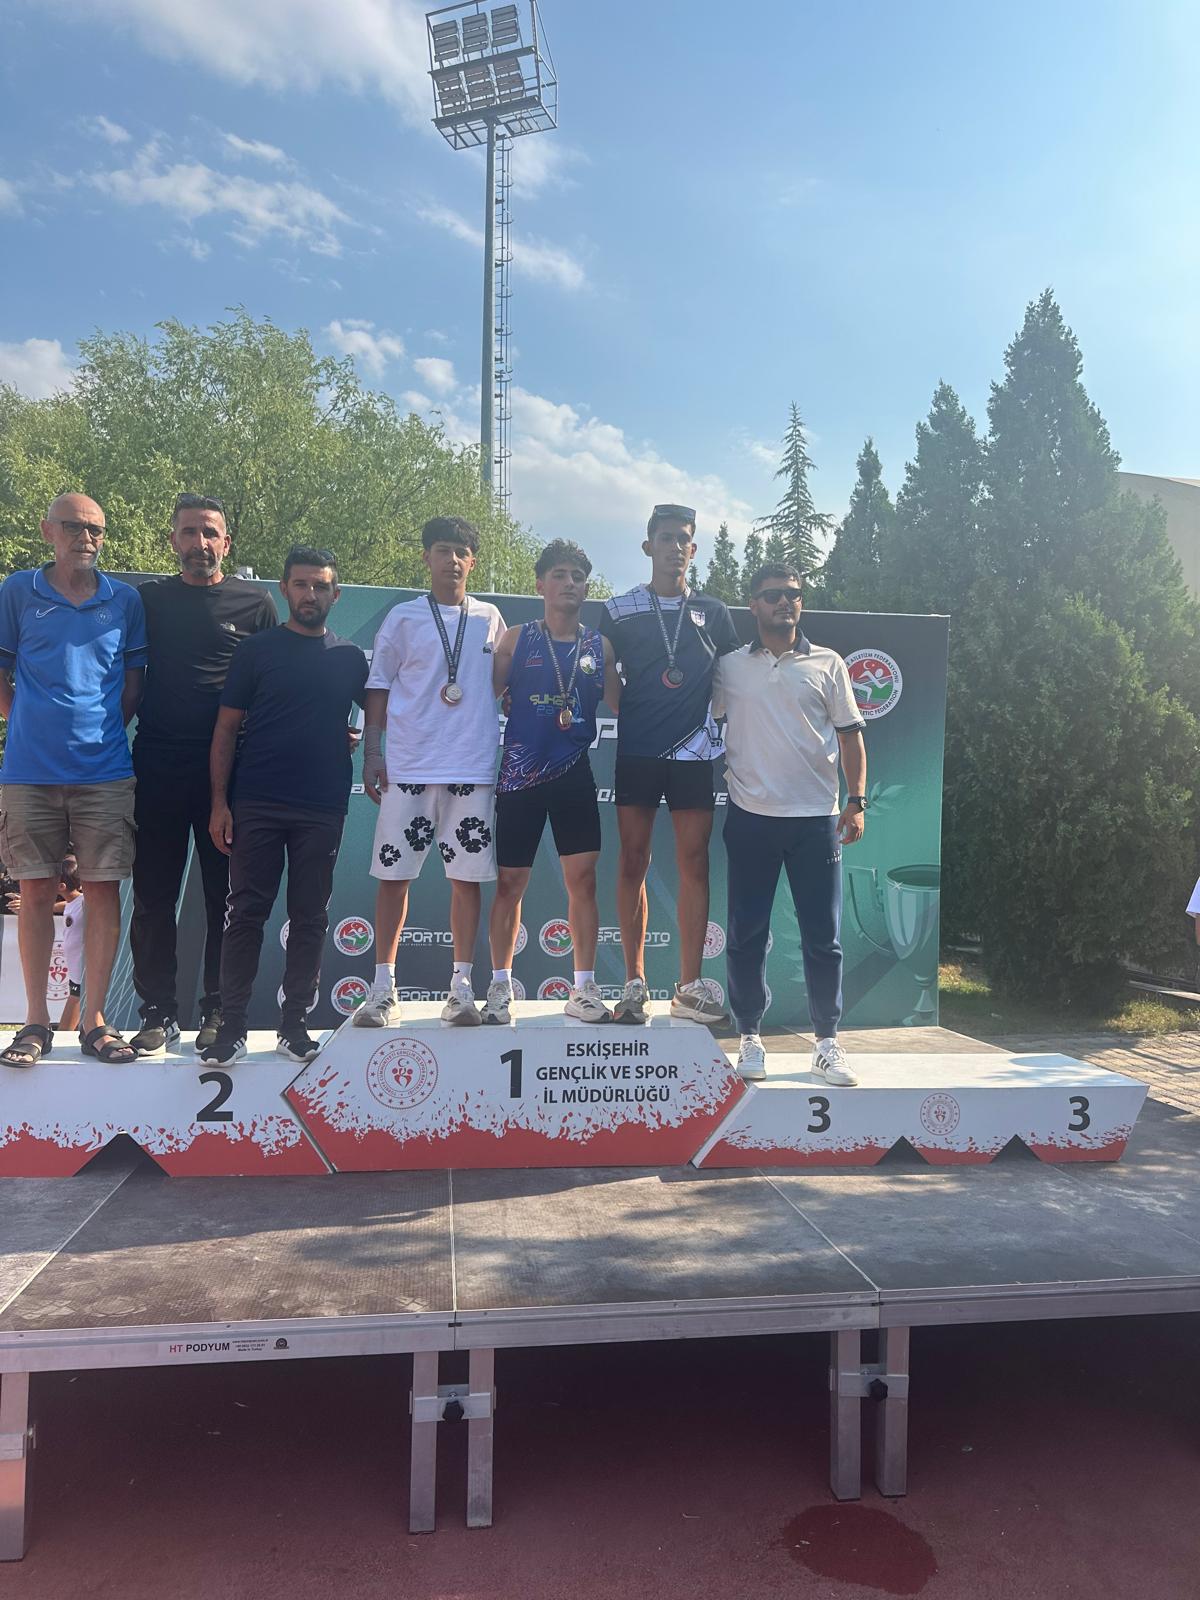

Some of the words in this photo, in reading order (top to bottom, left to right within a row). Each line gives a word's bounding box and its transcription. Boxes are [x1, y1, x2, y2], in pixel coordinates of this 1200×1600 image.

[398, 931, 454, 943] SPORTO
[566, 1040, 649, 1060] ESKİŞEHİR
[500, 1049, 522, 1098] 1
[536, 1063, 607, 1084] GENÇLİK
[610, 1065, 631, 1079] VE
[635, 1065, 678, 1079] SPOR
[196, 1071, 234, 1122] 2
[543, 1087, 558, 1104] İL
[561, 1085, 670, 1104] MÜDÜRLÜĞÜ
[807, 1095, 831, 1133] 3
[1068, 1095, 1091, 1132] 3
[169, 1344, 184, 1353] HT
[185, 1342, 230, 1353] PODYUM
